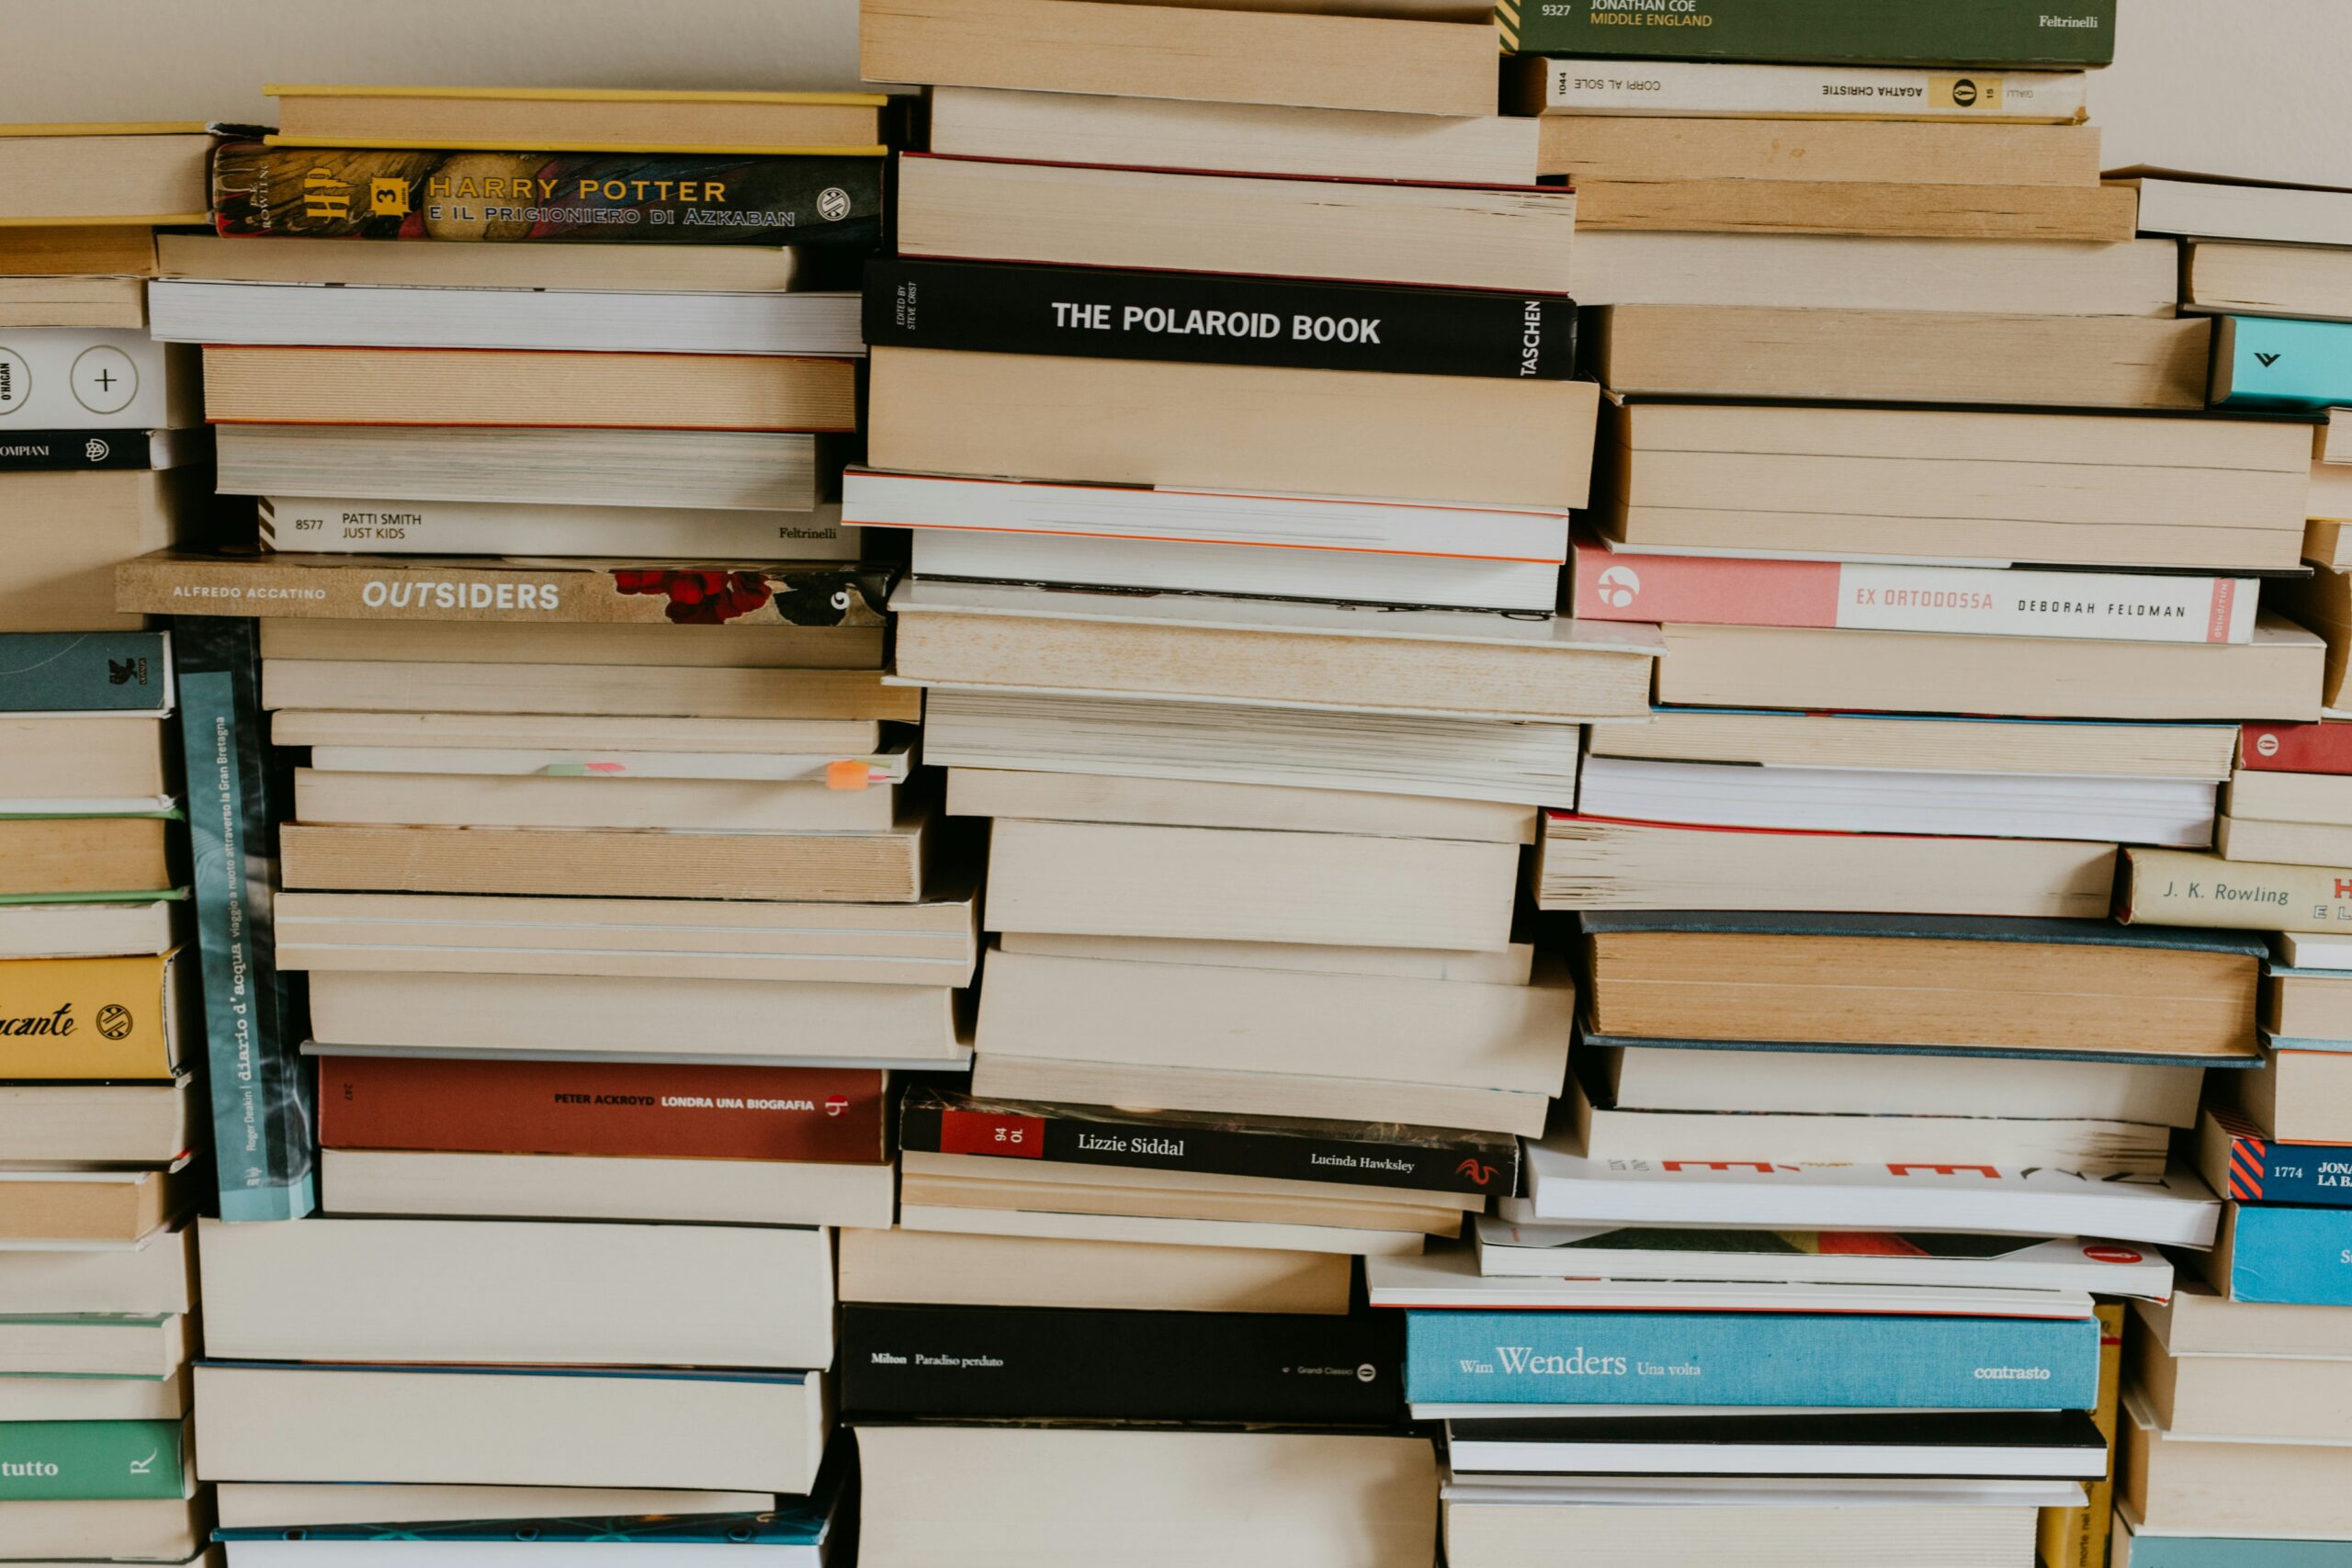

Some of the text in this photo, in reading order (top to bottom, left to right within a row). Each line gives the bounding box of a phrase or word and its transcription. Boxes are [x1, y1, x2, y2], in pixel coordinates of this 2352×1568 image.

[1542, 5, 1571, 17] 9327
[1590, 0, 1696, 12] JONATHAN COE
[1590, 13, 1713, 28] MIDDLE ENGLAND
[2038, 15, 2098, 28] Feltrinelli
[1558, 72, 1567, 96] 1044
[1574, 78, 1661, 92] CORPI AL SOLE
[1822, 85, 1923, 98] AGATHA CHRISTIE
[428, 177, 727, 202] HARRY POTTER
[428, 206, 796, 227] E IL PRIGIONIERO DI AZKABAN
[897, 285, 906, 326] EDITED BY
[907, 281, 918, 331] STEVE CRIST
[1052, 302, 1381, 344] THE POLAROID BOOK
[1521, 300, 1541, 377] TASCHEN
[0, 363, 12, 400] O'HAGAN
[295, 520, 323, 530] 8577
[342, 513, 422, 525] PATTI SMITH
[343, 527, 405, 539] JUST KIDS
[779, 527, 837, 539] Feltrinelli
[173, 586, 327, 601] ALFREDO ACCATINO
[361, 581, 560, 610] OUTSIDERS
[1856, 588, 1994, 610] EX ORTODOSSA
[2018, 600, 2186, 618] DEBORAH FELDMAN
[215, 716, 229, 765] Bretagna
[218, 766, 230, 792] Gran
[220, 792, 231, 803] la
[221, 804, 234, 856] attraverso
[226, 860, 237, 891] nuoto
[230, 892, 237, 900] a
[2163, 881, 2289, 907] J. K. Rowling
[230, 900, 242, 938] viaggio
[230, 942, 247, 1014] d'acqua
[235, 1018, 252, 1081] diario
[242, 1090, 255, 1124] Deakin
[554, 1093, 815, 1111] PETER ACKROYD LONDRA UNA BIOGRAFIA
[243, 1125, 259, 1152] Roger
[995, 1127, 1007, 1142] 94
[1078, 1134, 1184, 1156] Lizzie Siddal
[1311, 1153, 1416, 1174] Lucinda Hawksley
[2274, 1166, 2303, 1179] 1774
[2317, 1175, 2337, 1186] LA
[871, 1352, 1004, 1368] Milton Paradiso perduto
[1459, 1347, 1702, 1376] Wim Wenders Una volta
[1973, 1366, 2052, 1380] contrasto
[0, 1461, 59, 1477] tutto
[2081, 1514, 2091, 1530] nel
[2079, 1534, 2089, 1568] morte
